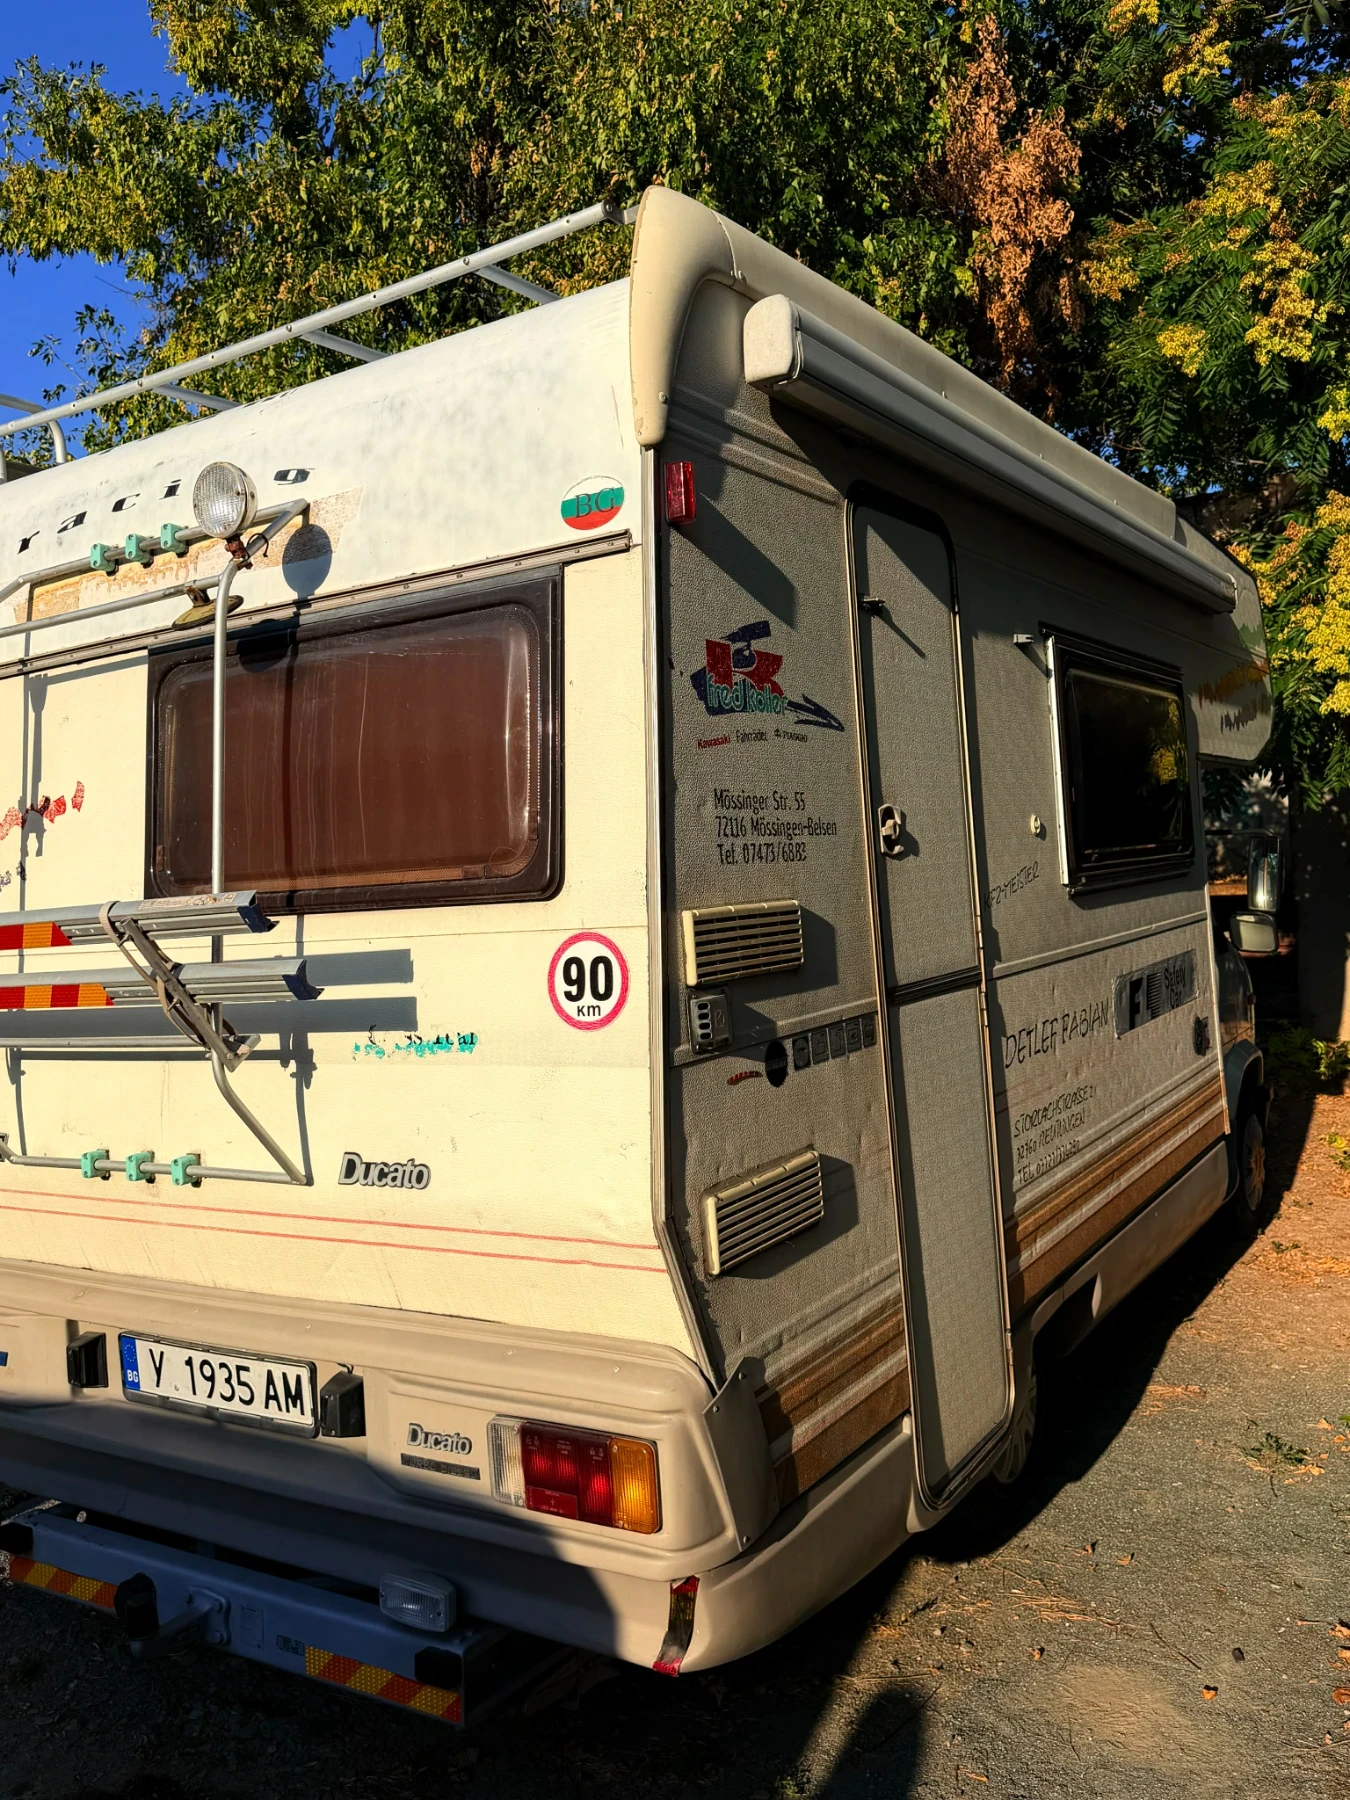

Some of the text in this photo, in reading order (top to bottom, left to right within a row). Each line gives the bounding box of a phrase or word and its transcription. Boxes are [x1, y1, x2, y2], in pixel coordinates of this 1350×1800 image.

[574, 486, 615, 519] BG
[697, 735, 731, 750] Kawasaki
[714, 788, 806, 814] Mössinger Str. 55
[715, 815, 837, 841] 72116 Mössingen-Belsen
[717, 843, 738, 865] Tel.
[563, 956, 614, 1002] 90
[1164, 964, 1186, 989] Safety
[1005, 997, 1109, 1069] DETLEF FABIAN
[338, 1152, 431, 1189] Ducato
[127, 1369, 139, 1384] BG
[149, 1348, 305, 1416] Y 1935 AM
[406, 1423, 473, 1456] Ducato
